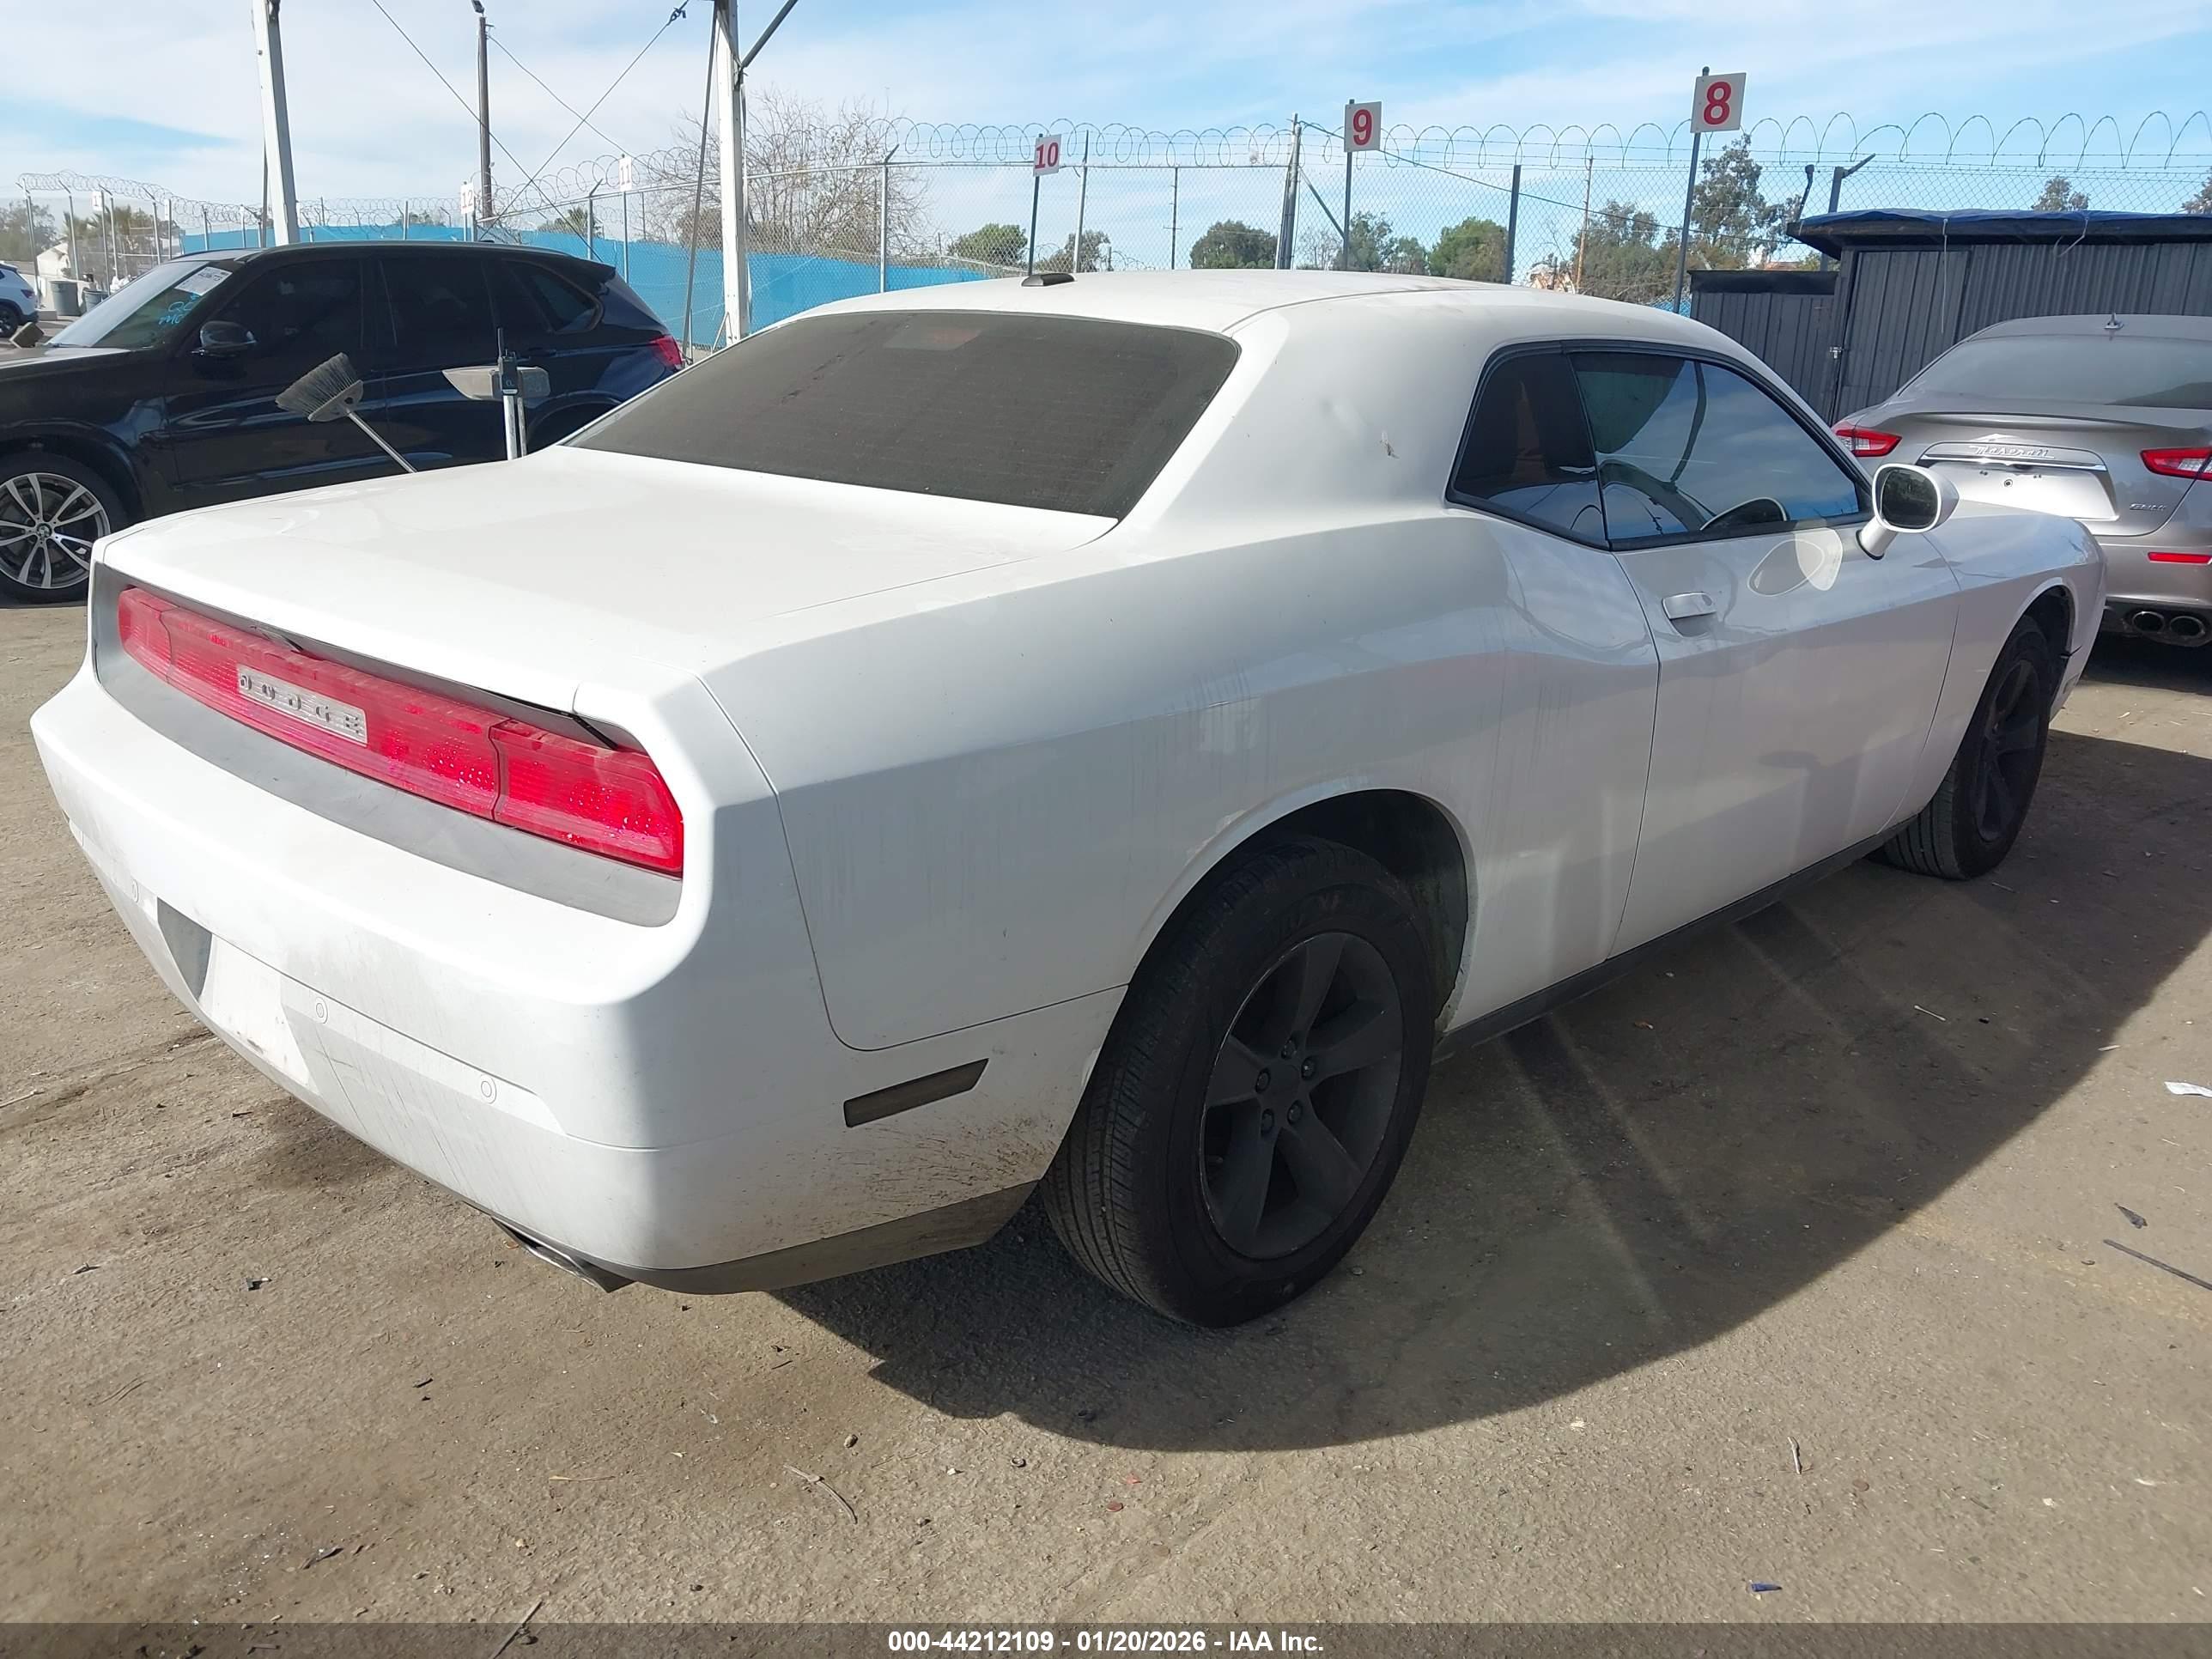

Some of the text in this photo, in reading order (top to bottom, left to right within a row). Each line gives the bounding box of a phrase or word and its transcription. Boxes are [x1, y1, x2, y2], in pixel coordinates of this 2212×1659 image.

[1704, 82, 1732, 125] 8
[1352, 109, 1372, 146] 9
[1035, 142, 1059, 169] 10
[620, 165, 630, 185] 11
[462, 190, 473, 209] 12
[240, 673, 359, 734] DODGE
